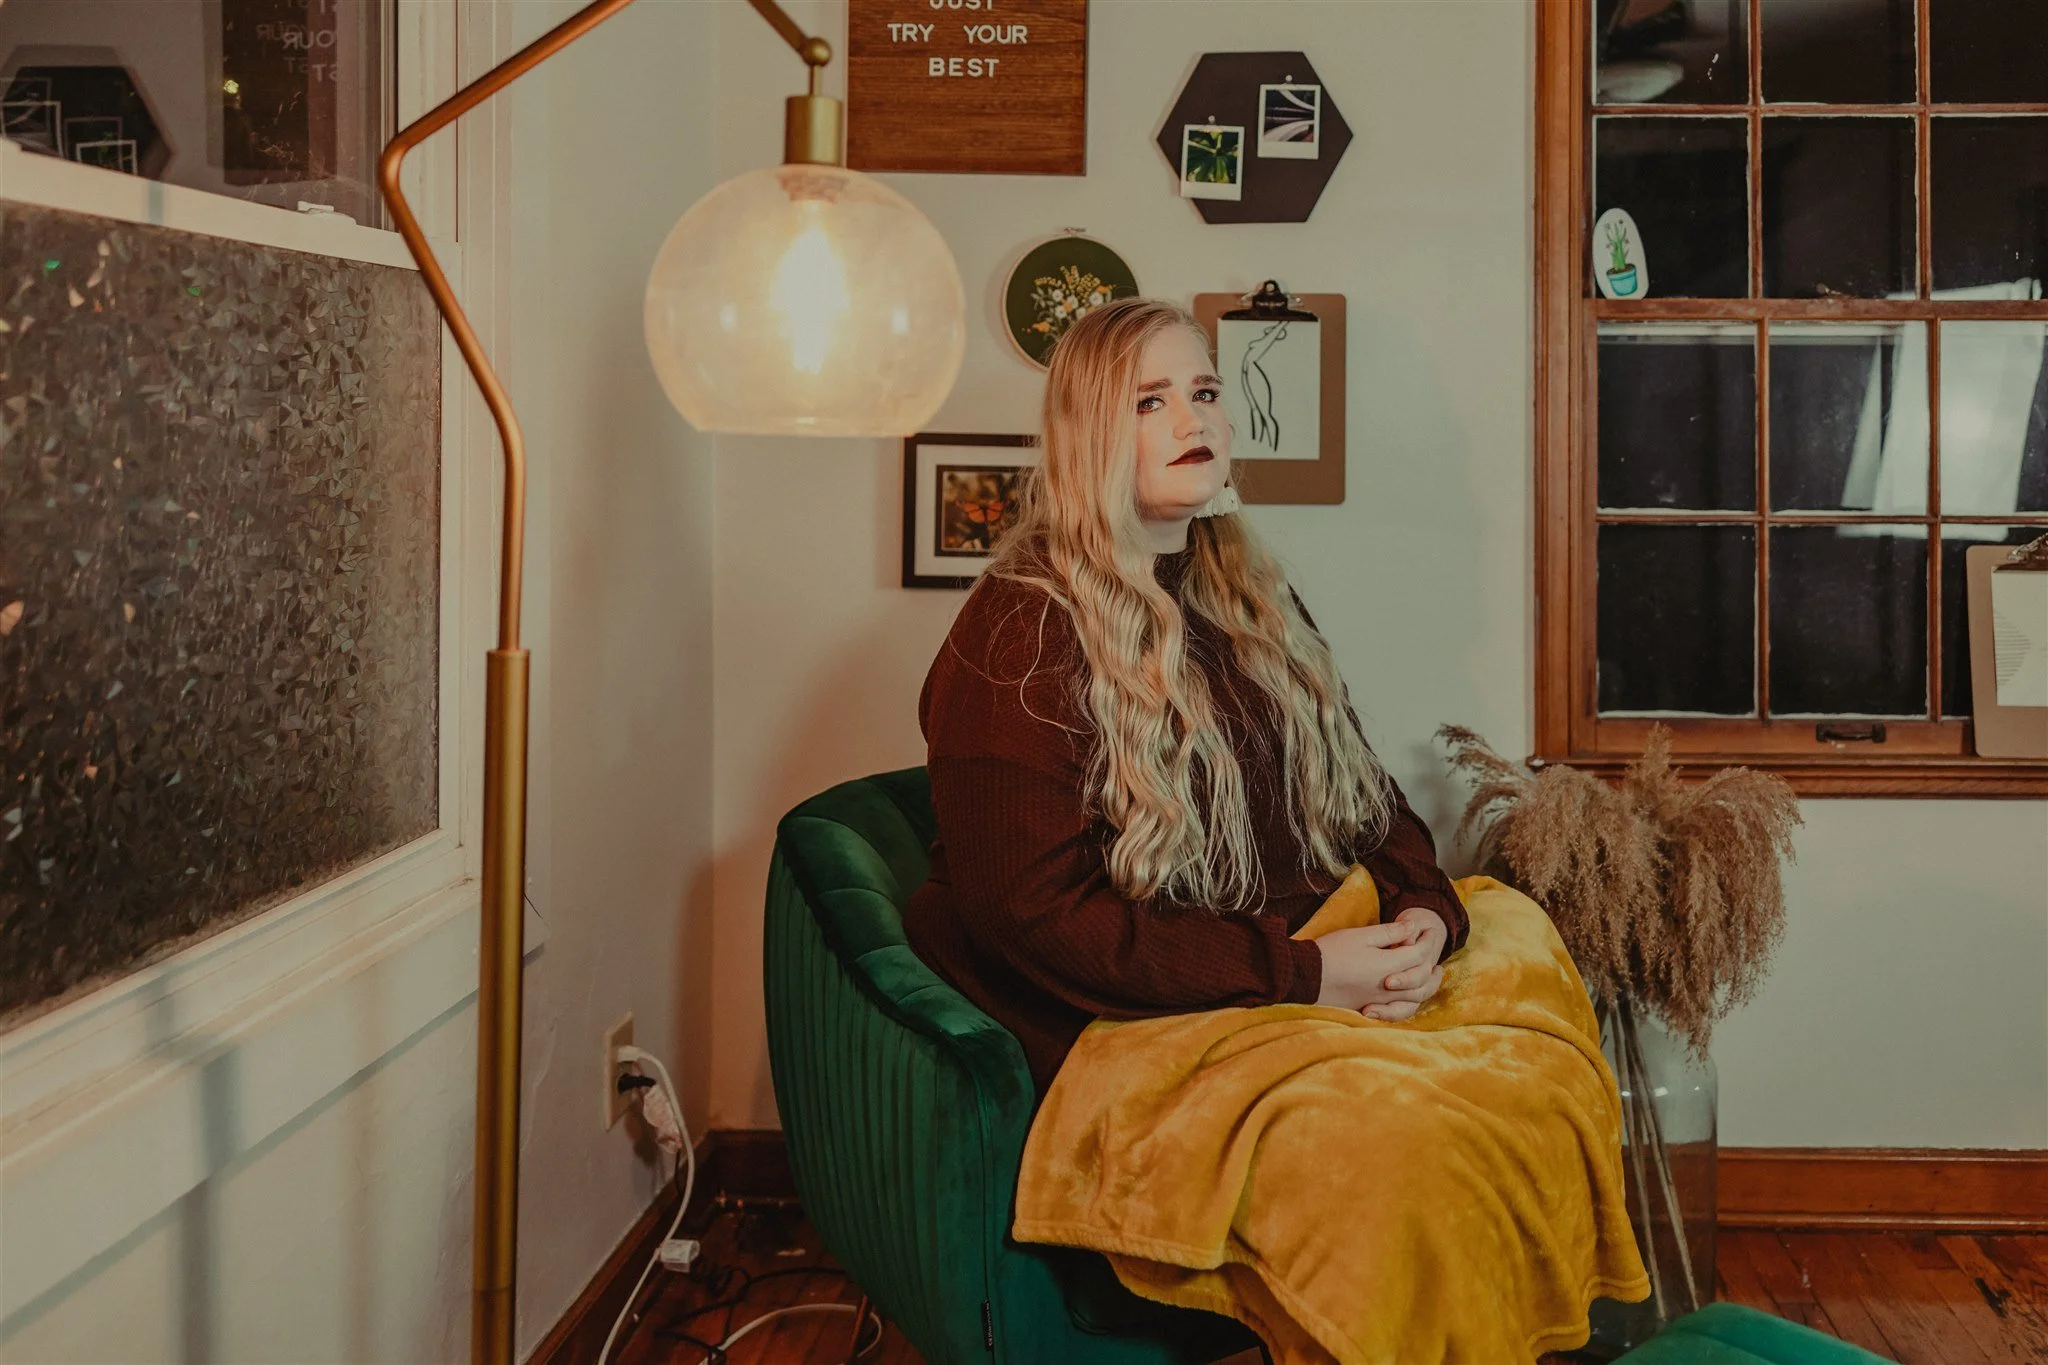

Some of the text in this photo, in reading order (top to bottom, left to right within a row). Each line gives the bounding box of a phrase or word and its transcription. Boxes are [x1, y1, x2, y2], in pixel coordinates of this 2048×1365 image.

[887, 23, 1028, 44] TRY YOUR
[928, 57, 1000, 78] BEST
